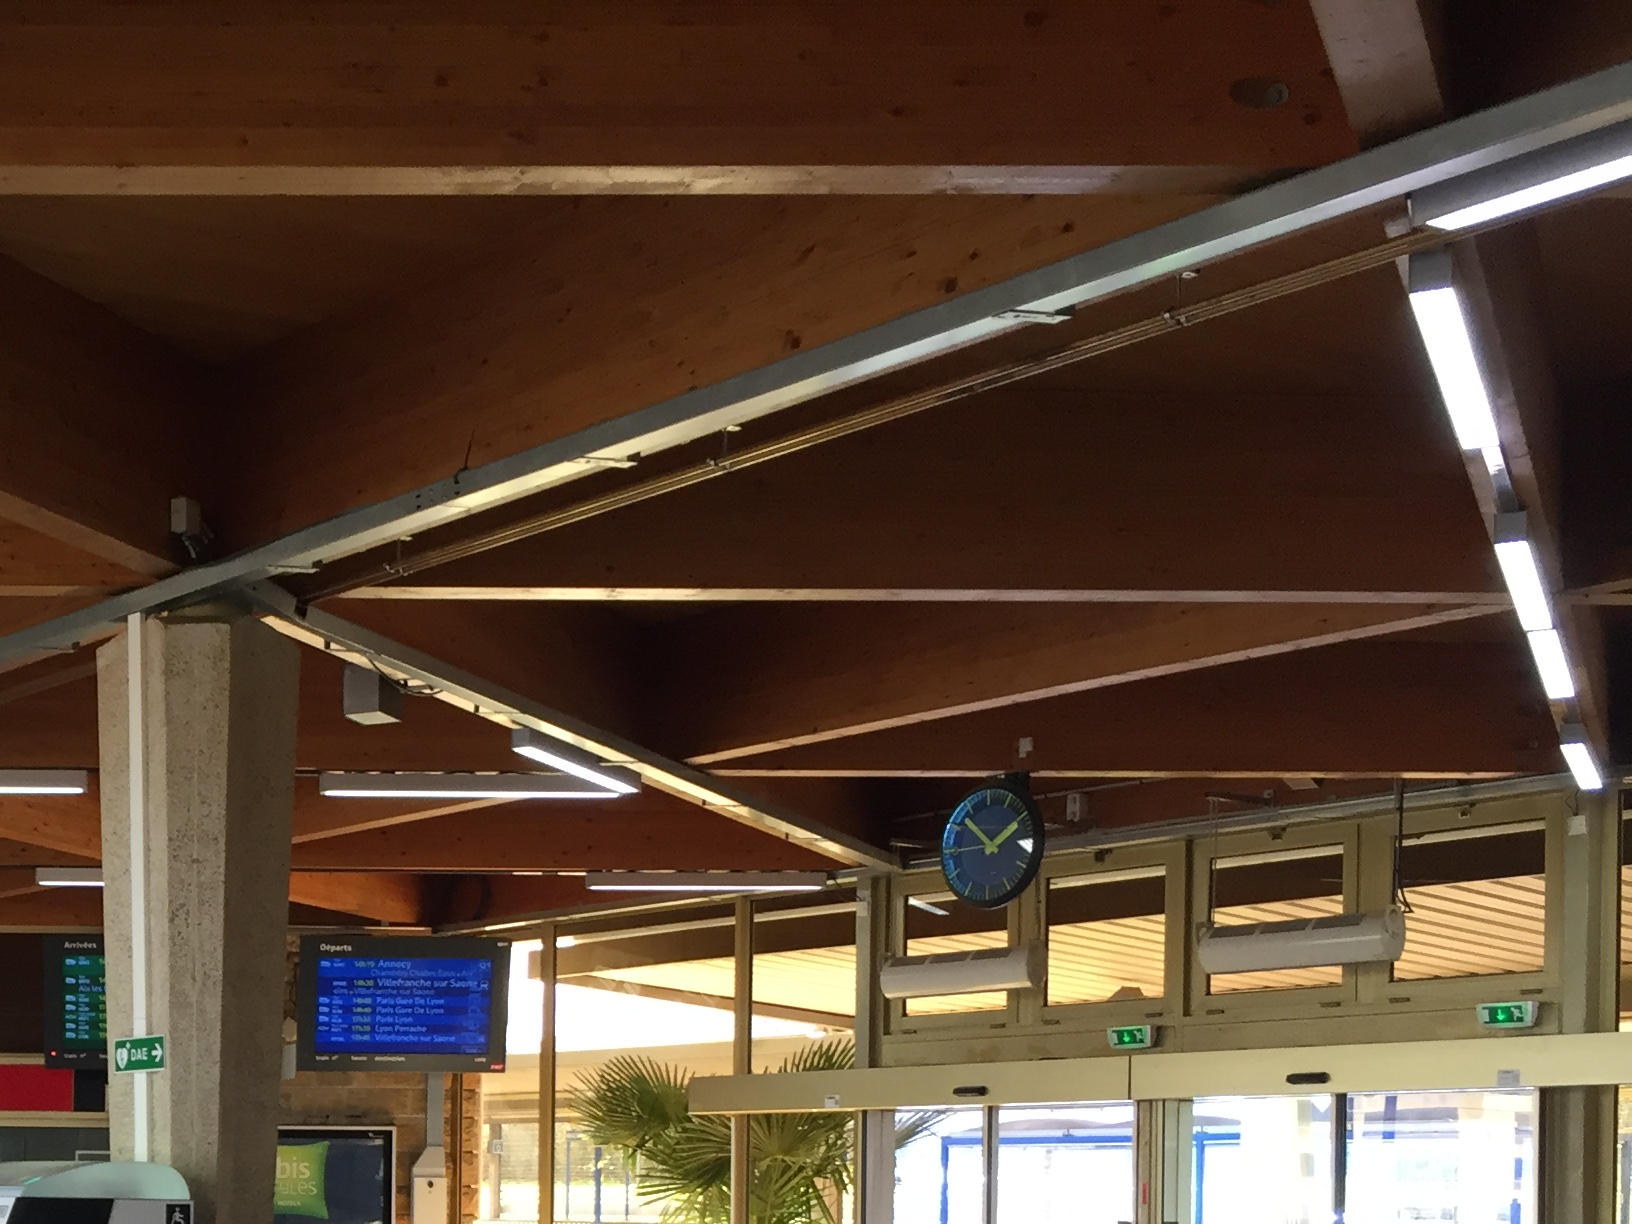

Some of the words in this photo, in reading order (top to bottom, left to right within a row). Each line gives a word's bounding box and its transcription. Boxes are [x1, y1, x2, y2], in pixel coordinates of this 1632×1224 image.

[320, 944, 352, 952] Départs
[378, 960, 412, 970] Annecy
[377, 978, 432, 988] Villefranche
[130, 1048, 148, 1061] DAE
